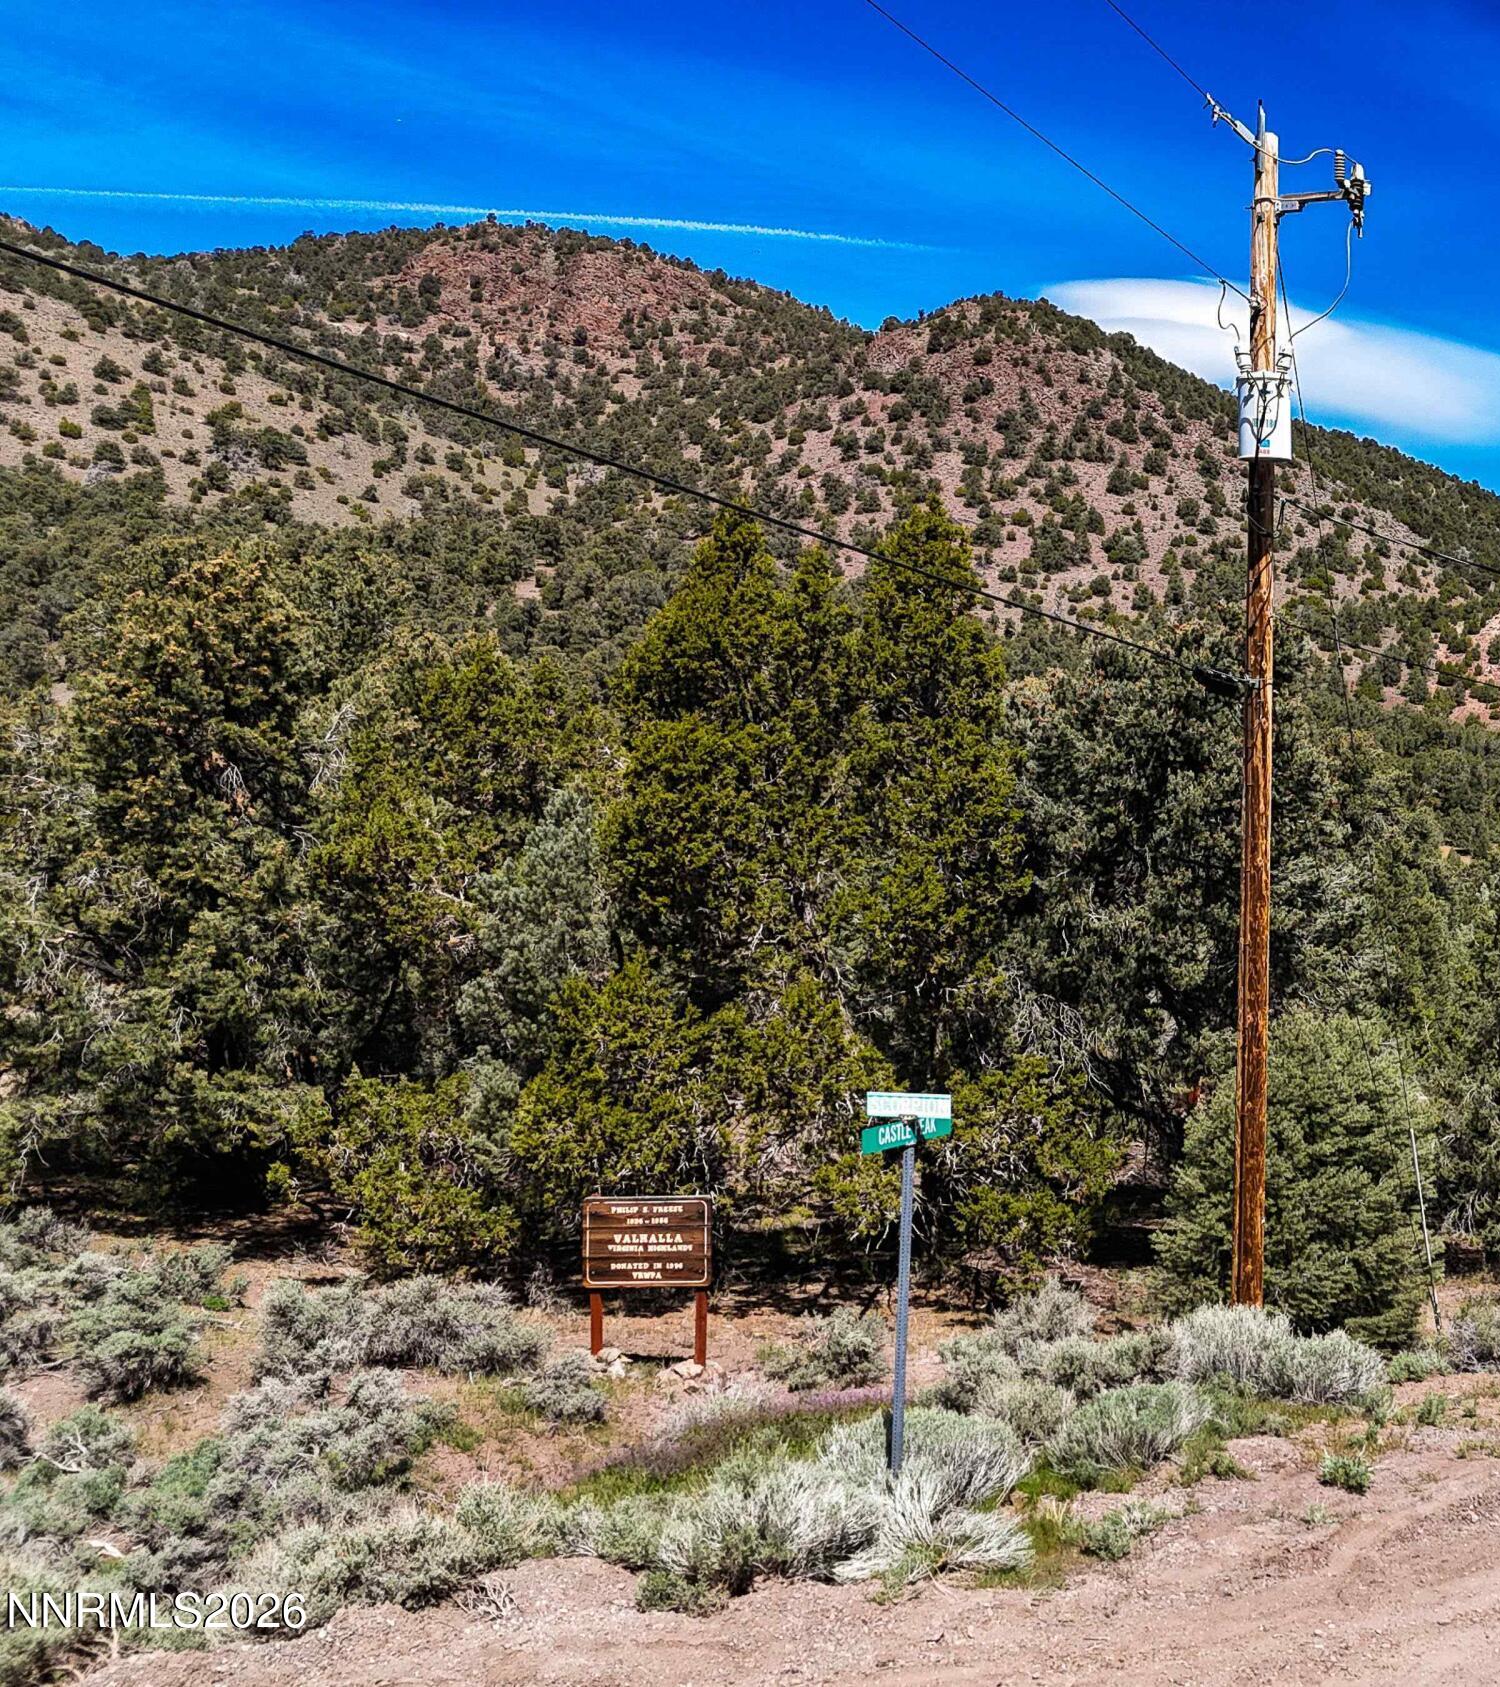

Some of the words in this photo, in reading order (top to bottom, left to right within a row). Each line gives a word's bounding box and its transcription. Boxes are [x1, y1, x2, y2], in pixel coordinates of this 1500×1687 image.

[879, 1123, 912, 1145] CASTLE
[916, 1119, 937, 1135] EAK
[611, 1206, 639, 1214] PHILIP
[613, 1234, 683, 1243] VALHALLA
[607, 1244, 644, 1252] VIRGINIA
[647, 1244, 693, 1252] HIGHLANDS
[610, 1262, 649, 1270] DONATED
[653, 1262, 662, 1270] IN
